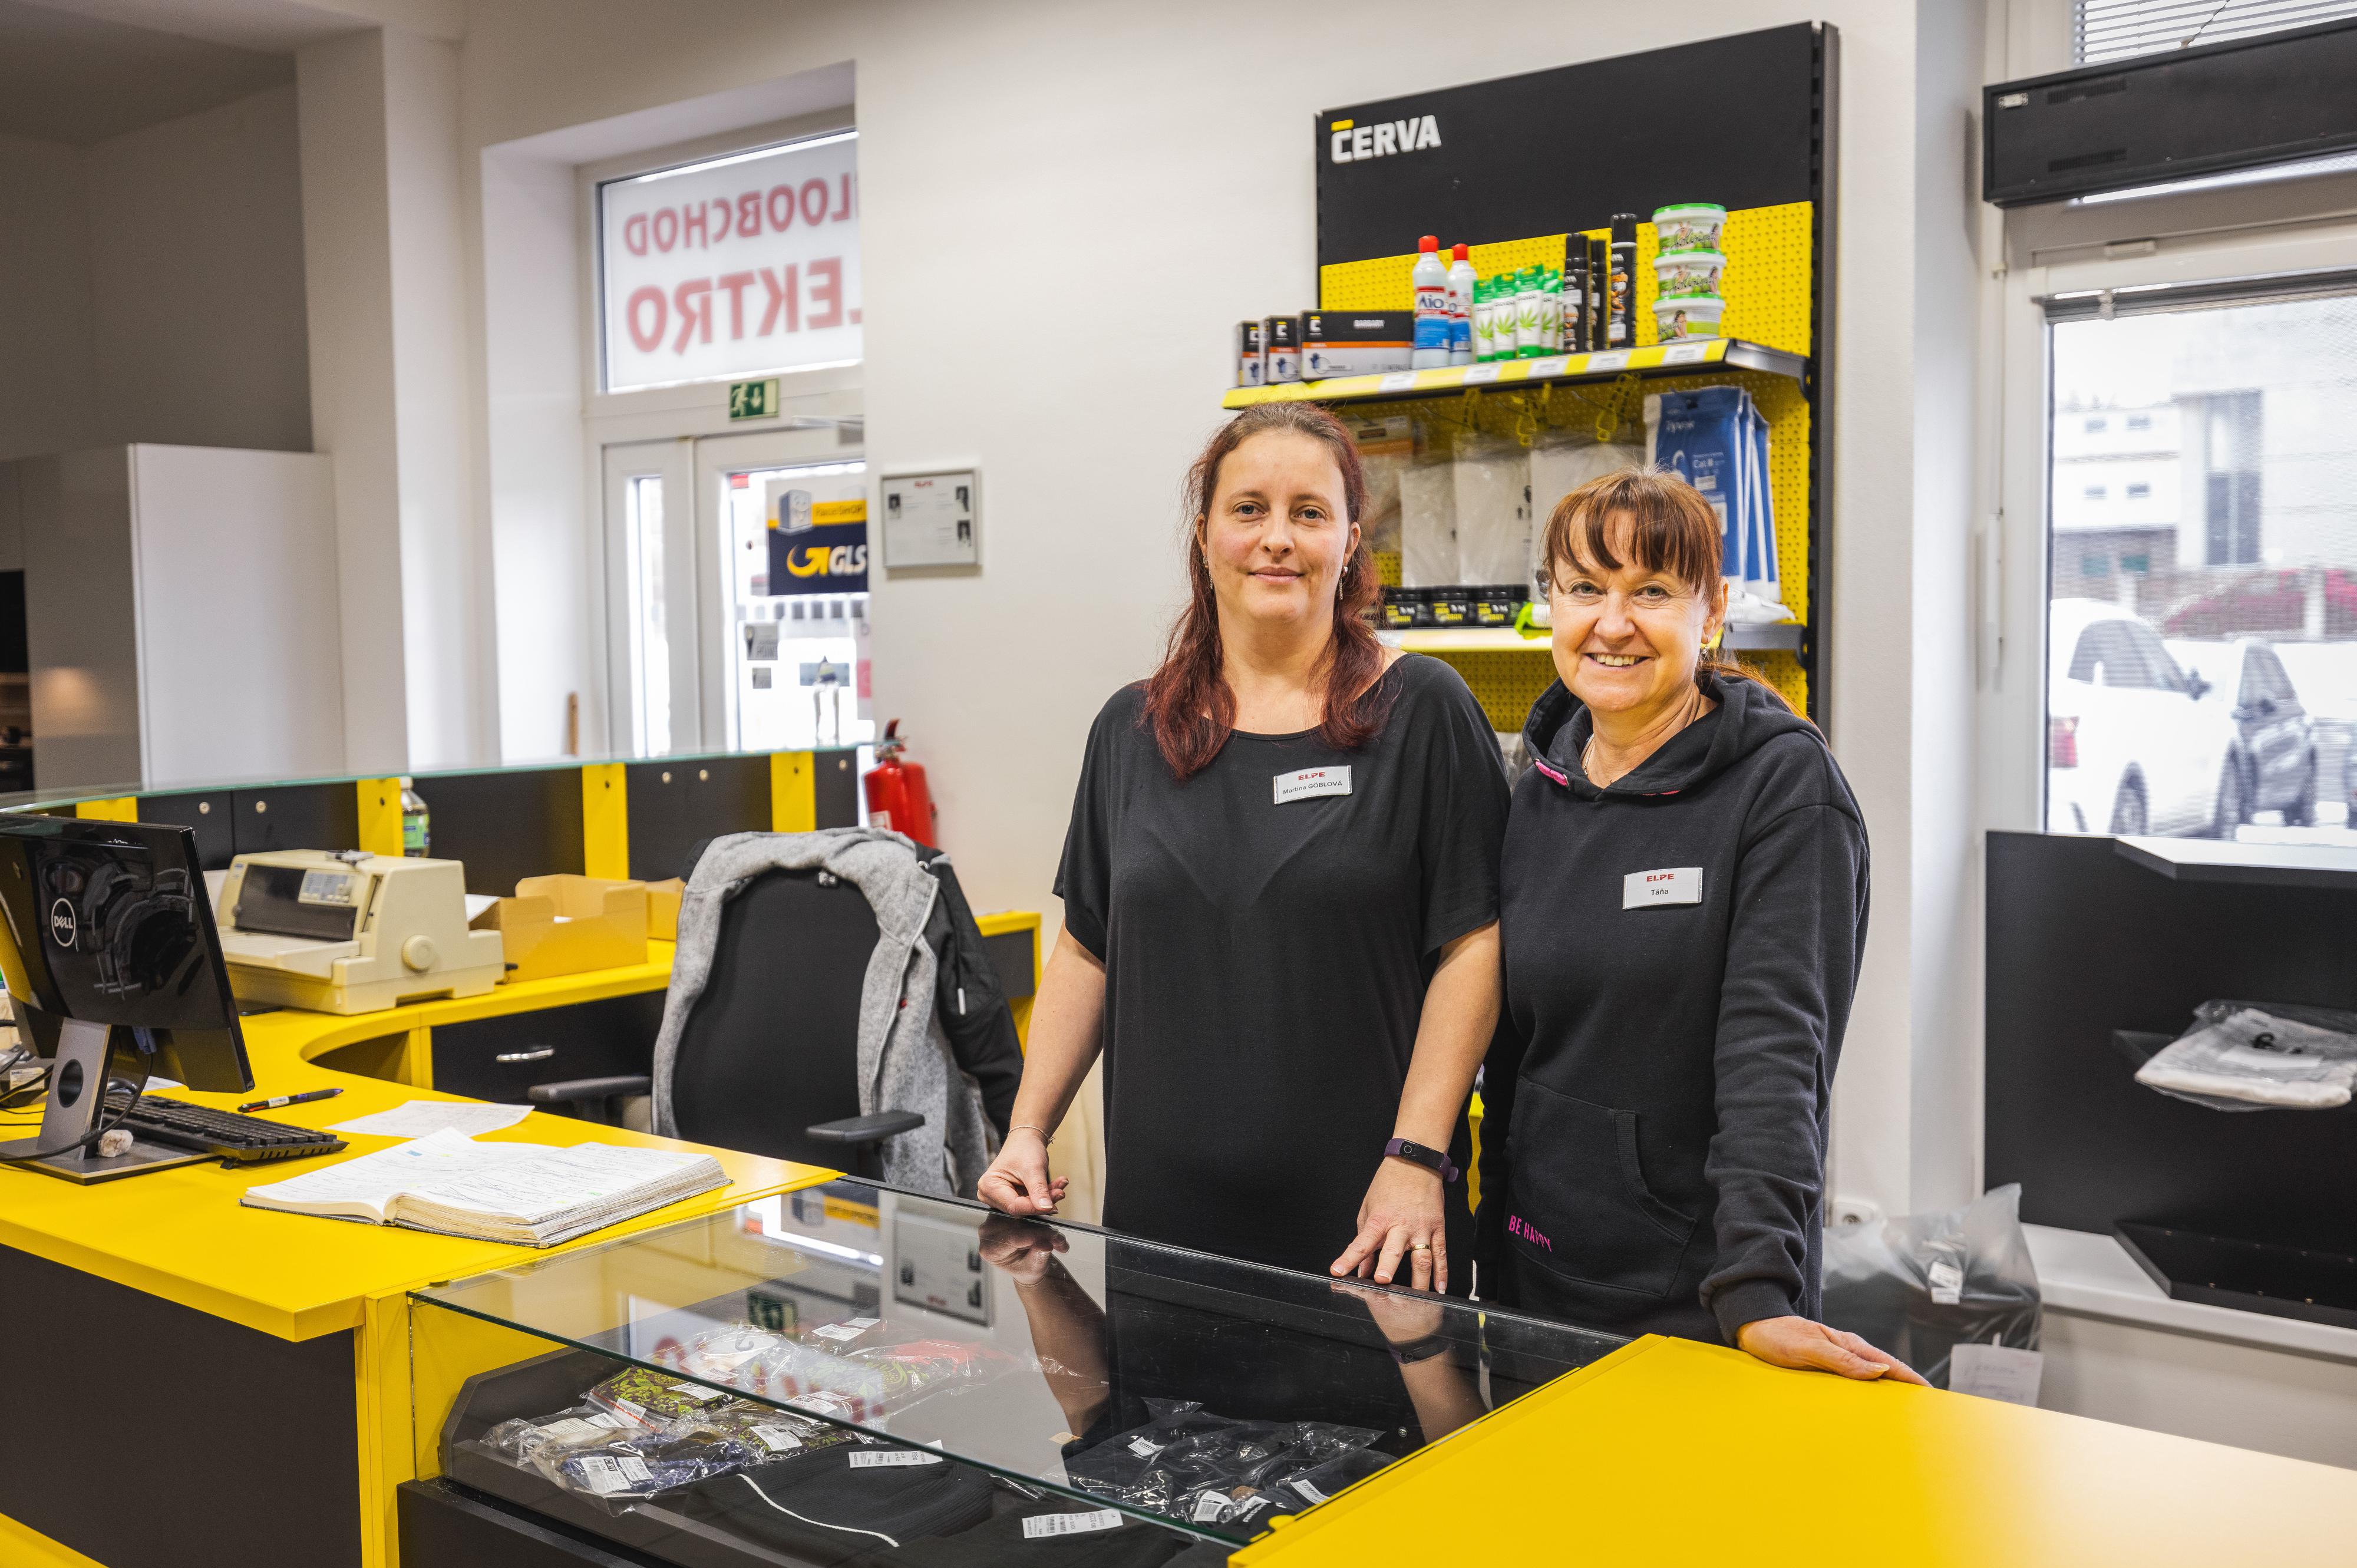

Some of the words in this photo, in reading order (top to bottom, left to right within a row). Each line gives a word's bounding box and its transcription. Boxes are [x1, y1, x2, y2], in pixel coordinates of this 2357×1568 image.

[828, 544, 867, 577] GLS
[1298, 771, 1326, 780] ELPE
[1283, 785, 1306, 794] Martina
[1308, 780, 1343, 789] GÖBLOVÁ
[1646, 873, 1675, 882] ELPE
[54, 915, 74, 929] DELL
[1508, 1215, 1522, 1235] BE
